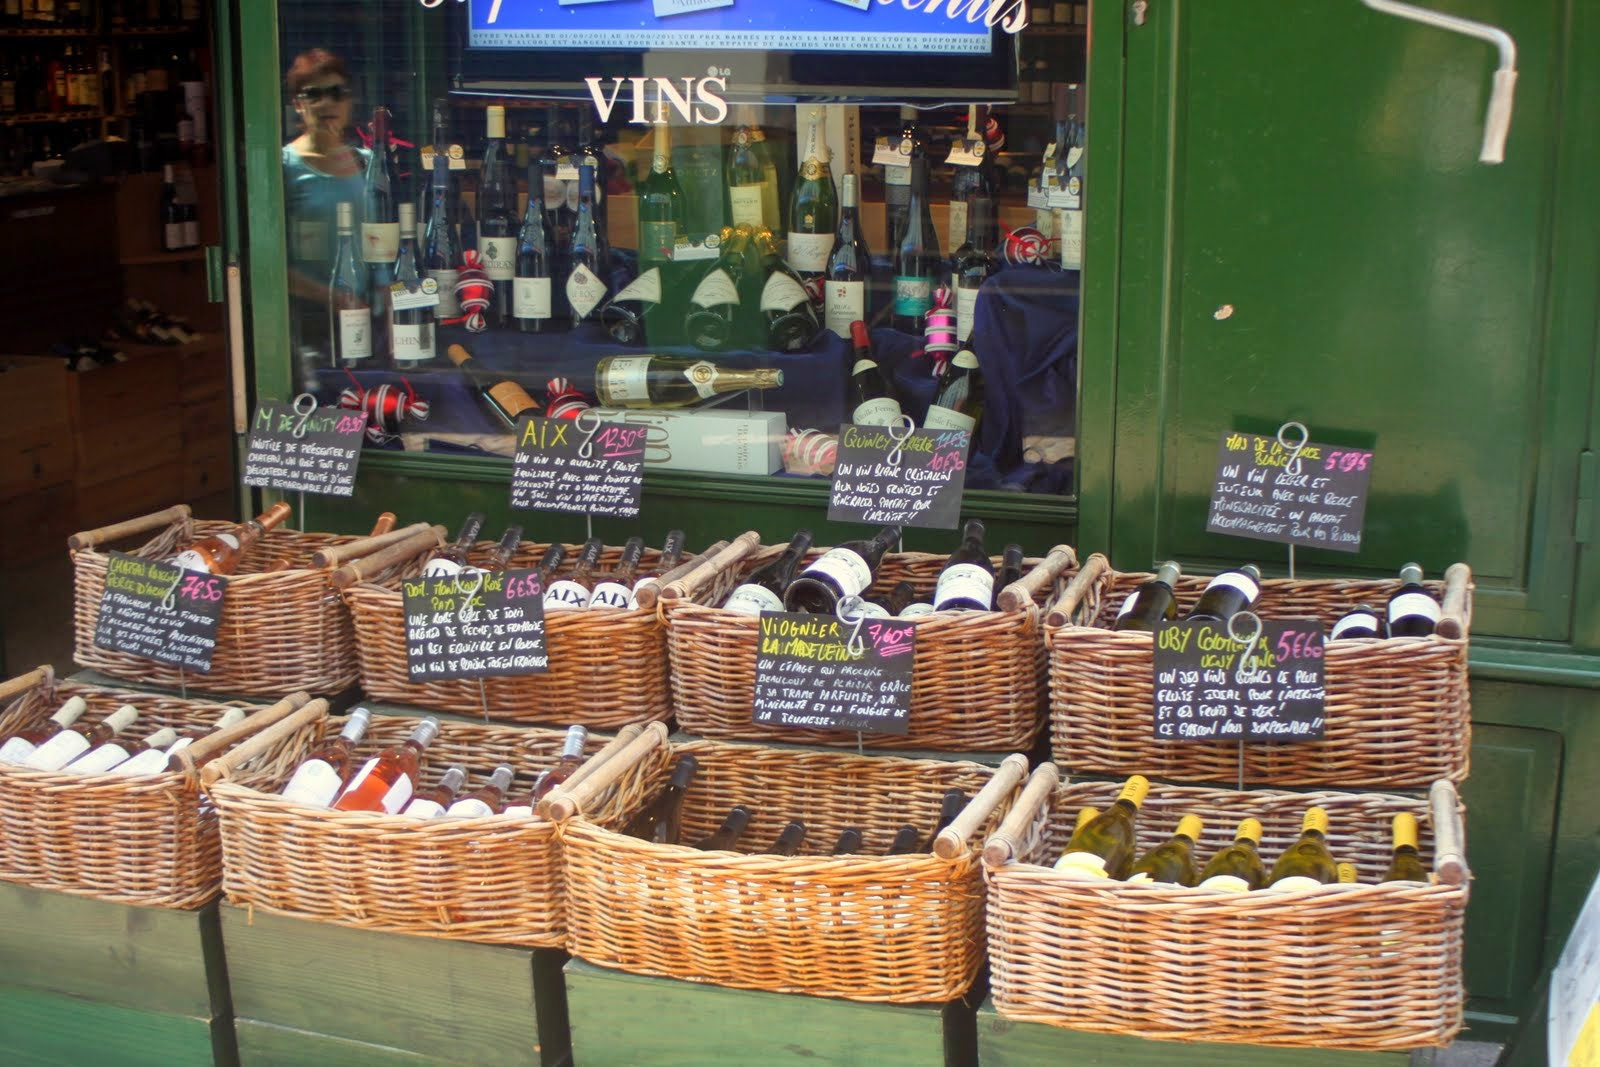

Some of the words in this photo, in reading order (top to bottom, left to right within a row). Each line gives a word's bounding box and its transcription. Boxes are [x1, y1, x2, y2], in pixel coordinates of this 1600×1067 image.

[584, 77, 729, 124] VINS
[256, 407, 273, 432] M
[285, 443, 297, 452] DE
[515, 452, 530, 464] UN
[555, 457, 565, 466] DE
[562, 472, 581, 482] AVEC
[838, 464, 853, 476] UN
[1223, 465, 1240, 478] UN
[1312, 478, 1330, 489] ET
[1272, 489, 1295, 502] AVEC
[1299, 496, 1320, 504] UNE
[181, 576, 222, 601] 7€50
[506, 573, 541, 599] 6€50
[545, 588, 587, 608] AIX
[409, 613, 428, 626] UNE
[445, 627, 457, 637] DE
[410, 645, 423, 656] UN
[498, 638, 514, 650] EN
[762, 637, 779, 656] LA
[1158, 626, 1192, 653] UBY
[1277, 630, 1323, 662] 5€60
[758, 660, 775, 670] UN
[841, 666, 883, 677] PROCURE
[1160, 668, 1176, 683] UN
[758, 674, 805, 686] BEAUCOUP
[813, 678, 826, 687] DE
[767, 688, 777, 697] SA
[783, 688, 814, 699] TRAME
[759, 712, 771, 720] SA
[813, 703, 825, 711] ET
[831, 704, 843, 713] LA
[850, 705, 890, 716] FOUGUE
[1158, 706, 1173, 719] ET
[1159, 724, 1175, 735] CE
